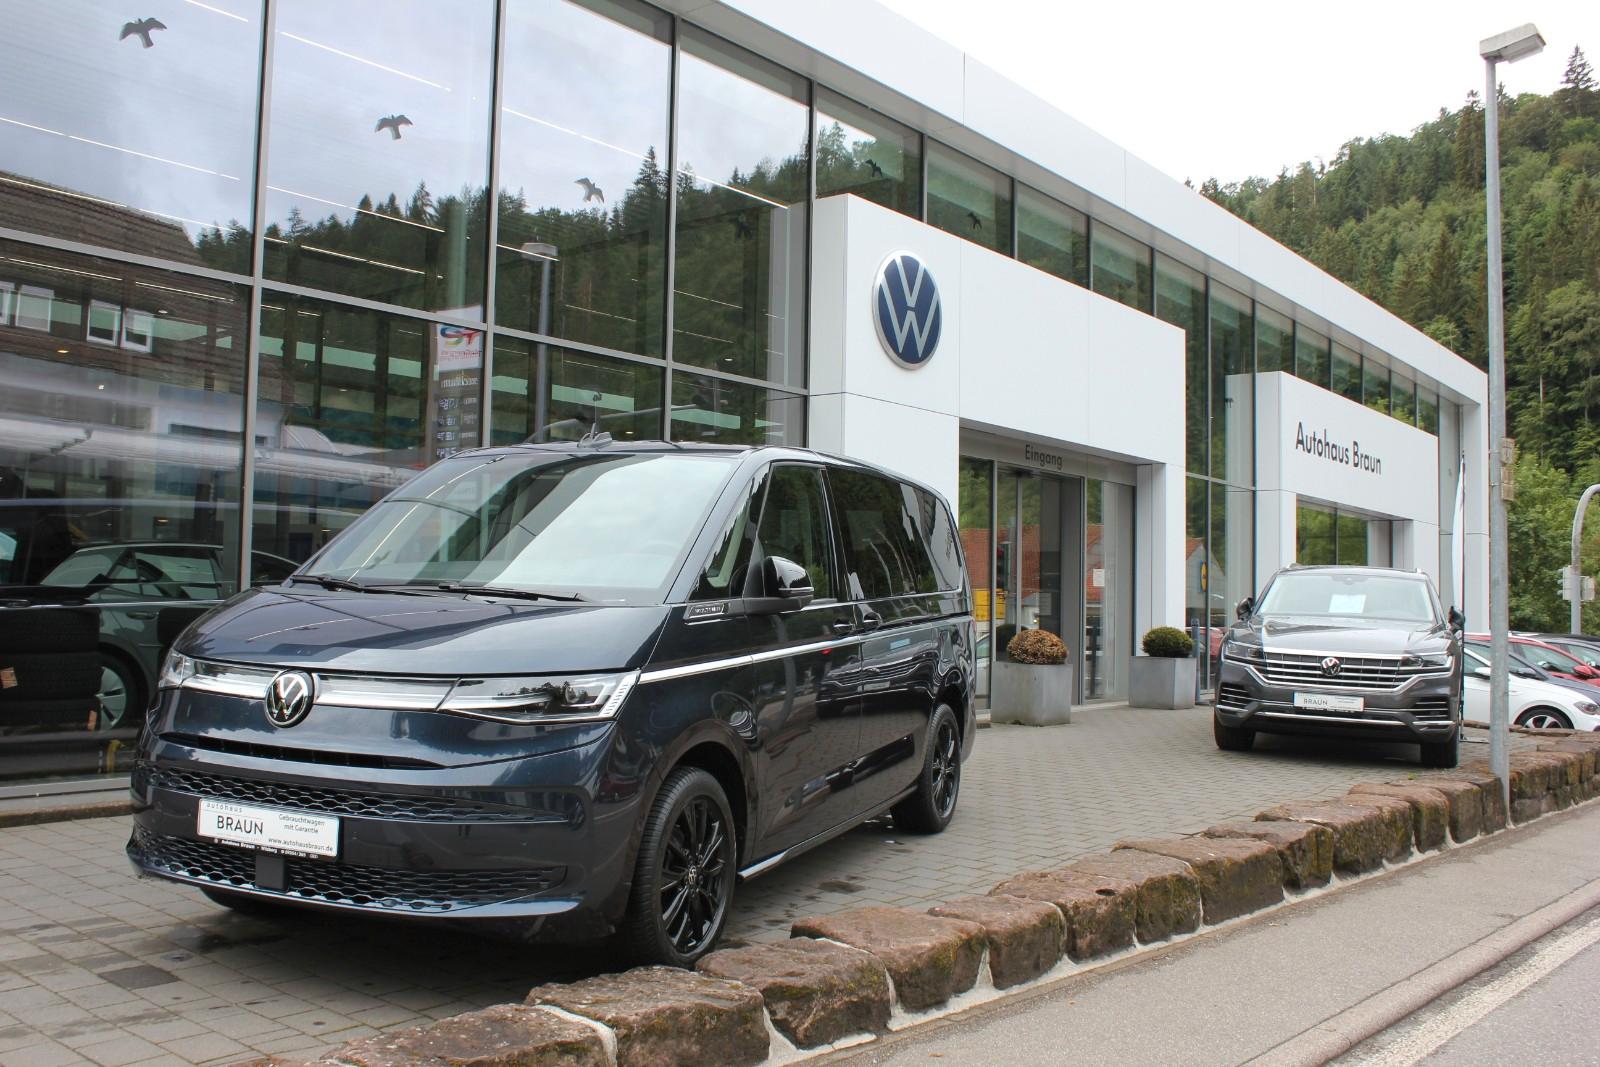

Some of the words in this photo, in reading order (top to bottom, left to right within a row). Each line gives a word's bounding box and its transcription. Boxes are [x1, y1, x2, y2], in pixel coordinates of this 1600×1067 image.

[876, 253, 941, 362] VW
[1296, 421, 1349, 465] Autohaus
[1353, 440, 1381, 475] Braun
[1025, 444, 1063, 470] Eingang
[266, 671, 309, 725] VW
[1304, 698, 1328, 706] BRAUN
[206, 803, 243, 813] autohaus
[217, 815, 264, 835] BRAUN
[279, 814, 325, 826] Gebrauchtwagen
[295, 824, 319, 833] Garantie
[268, 838, 334, 852] www.autohausbraun.de
